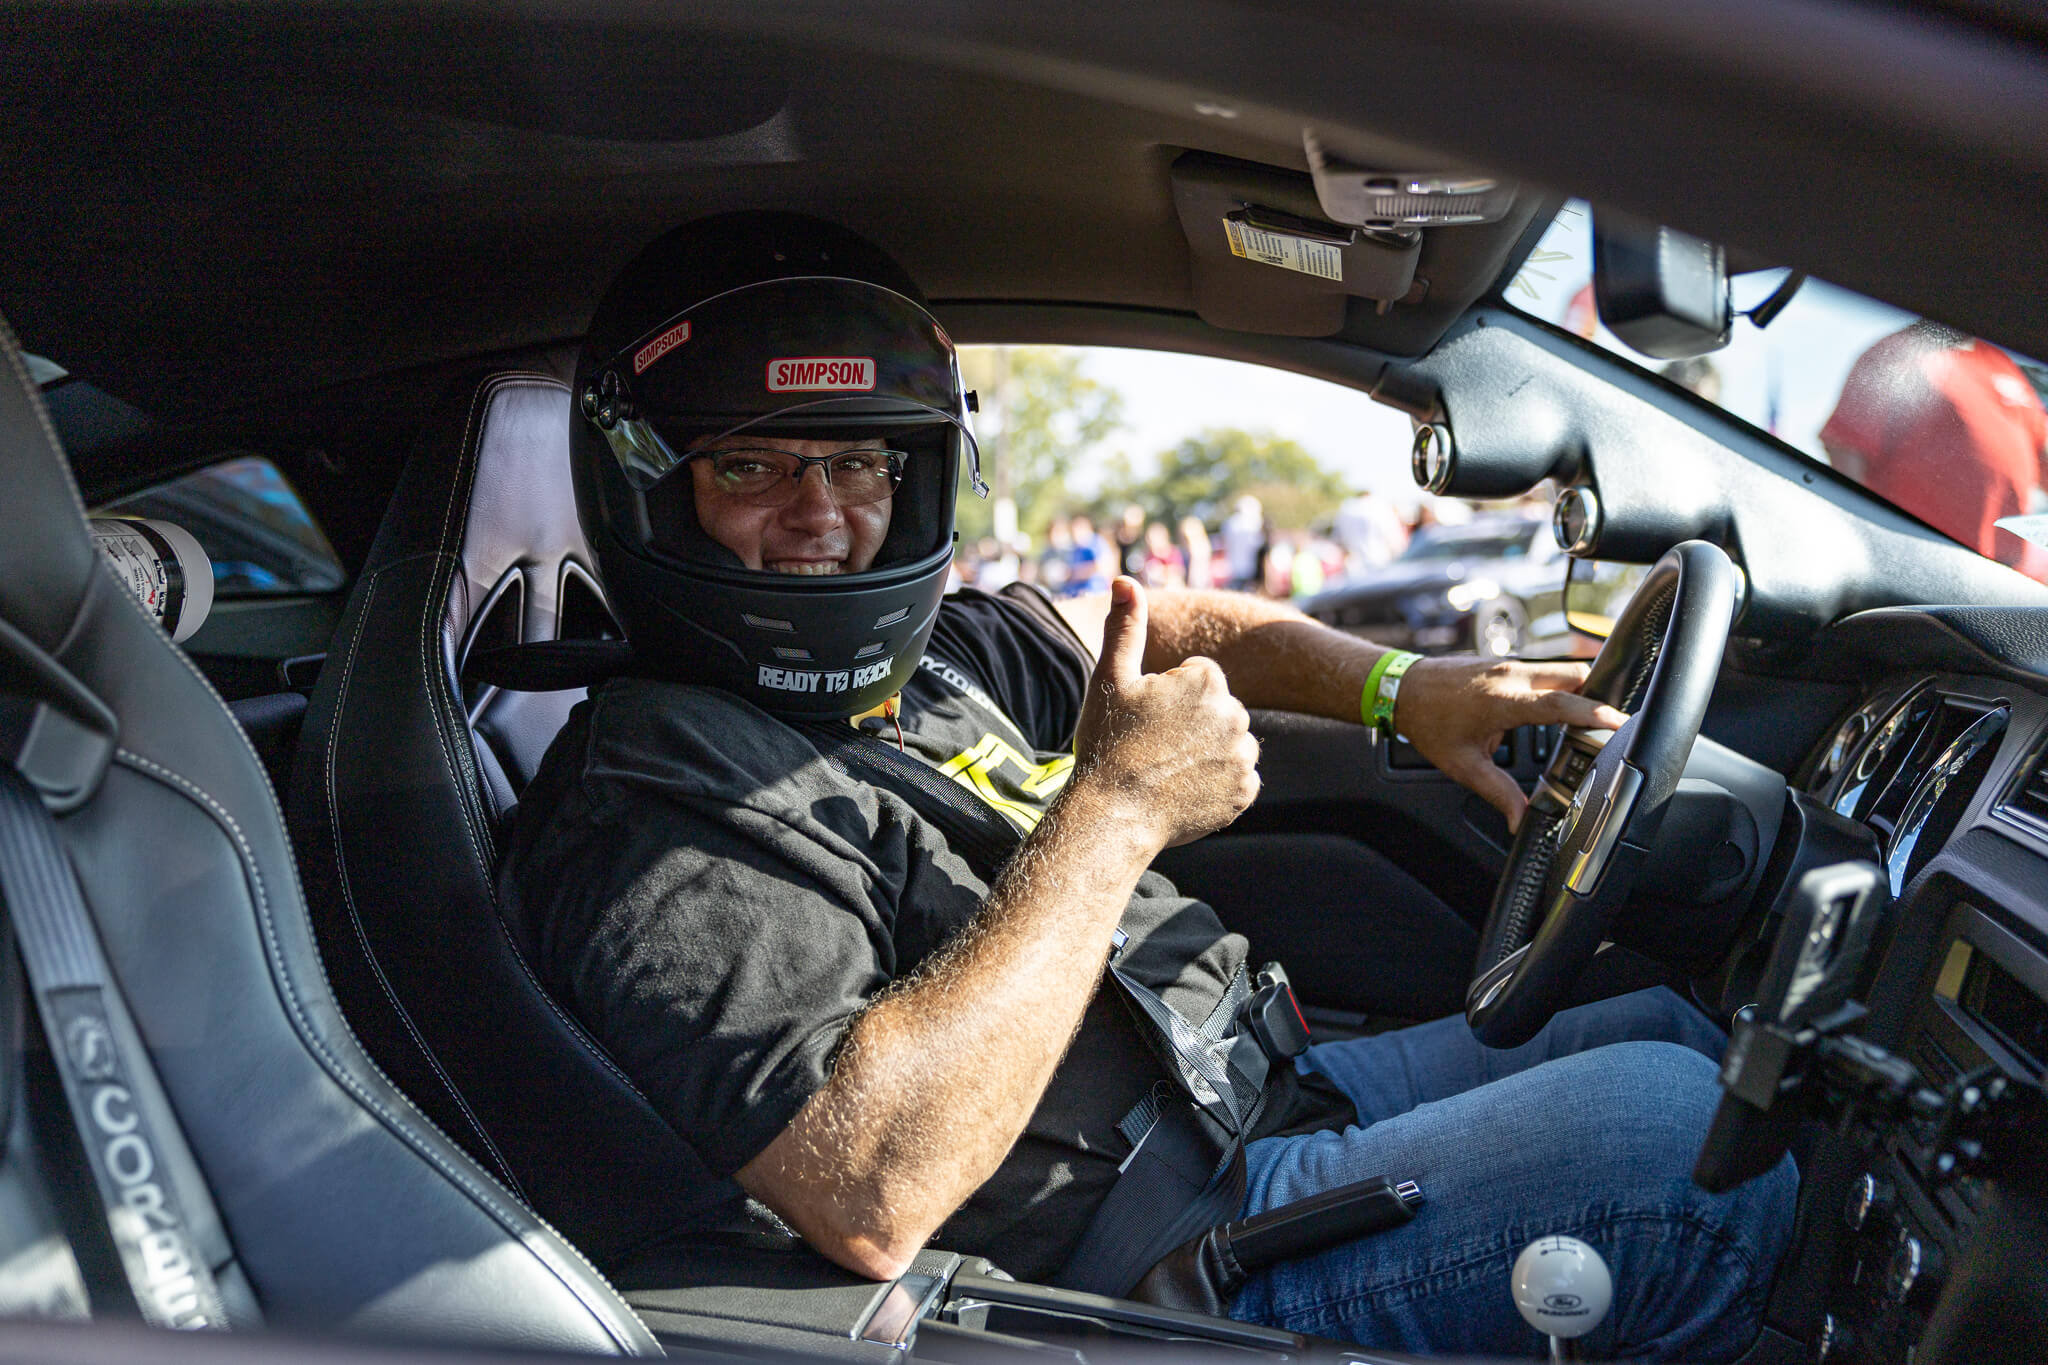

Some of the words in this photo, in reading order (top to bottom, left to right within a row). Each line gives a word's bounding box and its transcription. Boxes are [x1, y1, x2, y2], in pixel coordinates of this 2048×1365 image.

[637, 326, 684, 370] SIMPSON
[776, 361, 865, 386] SIMPSON
[758, 665, 822, 693] READY
[825, 671, 849, 693] TO
[852, 656, 894, 688] ROCK
